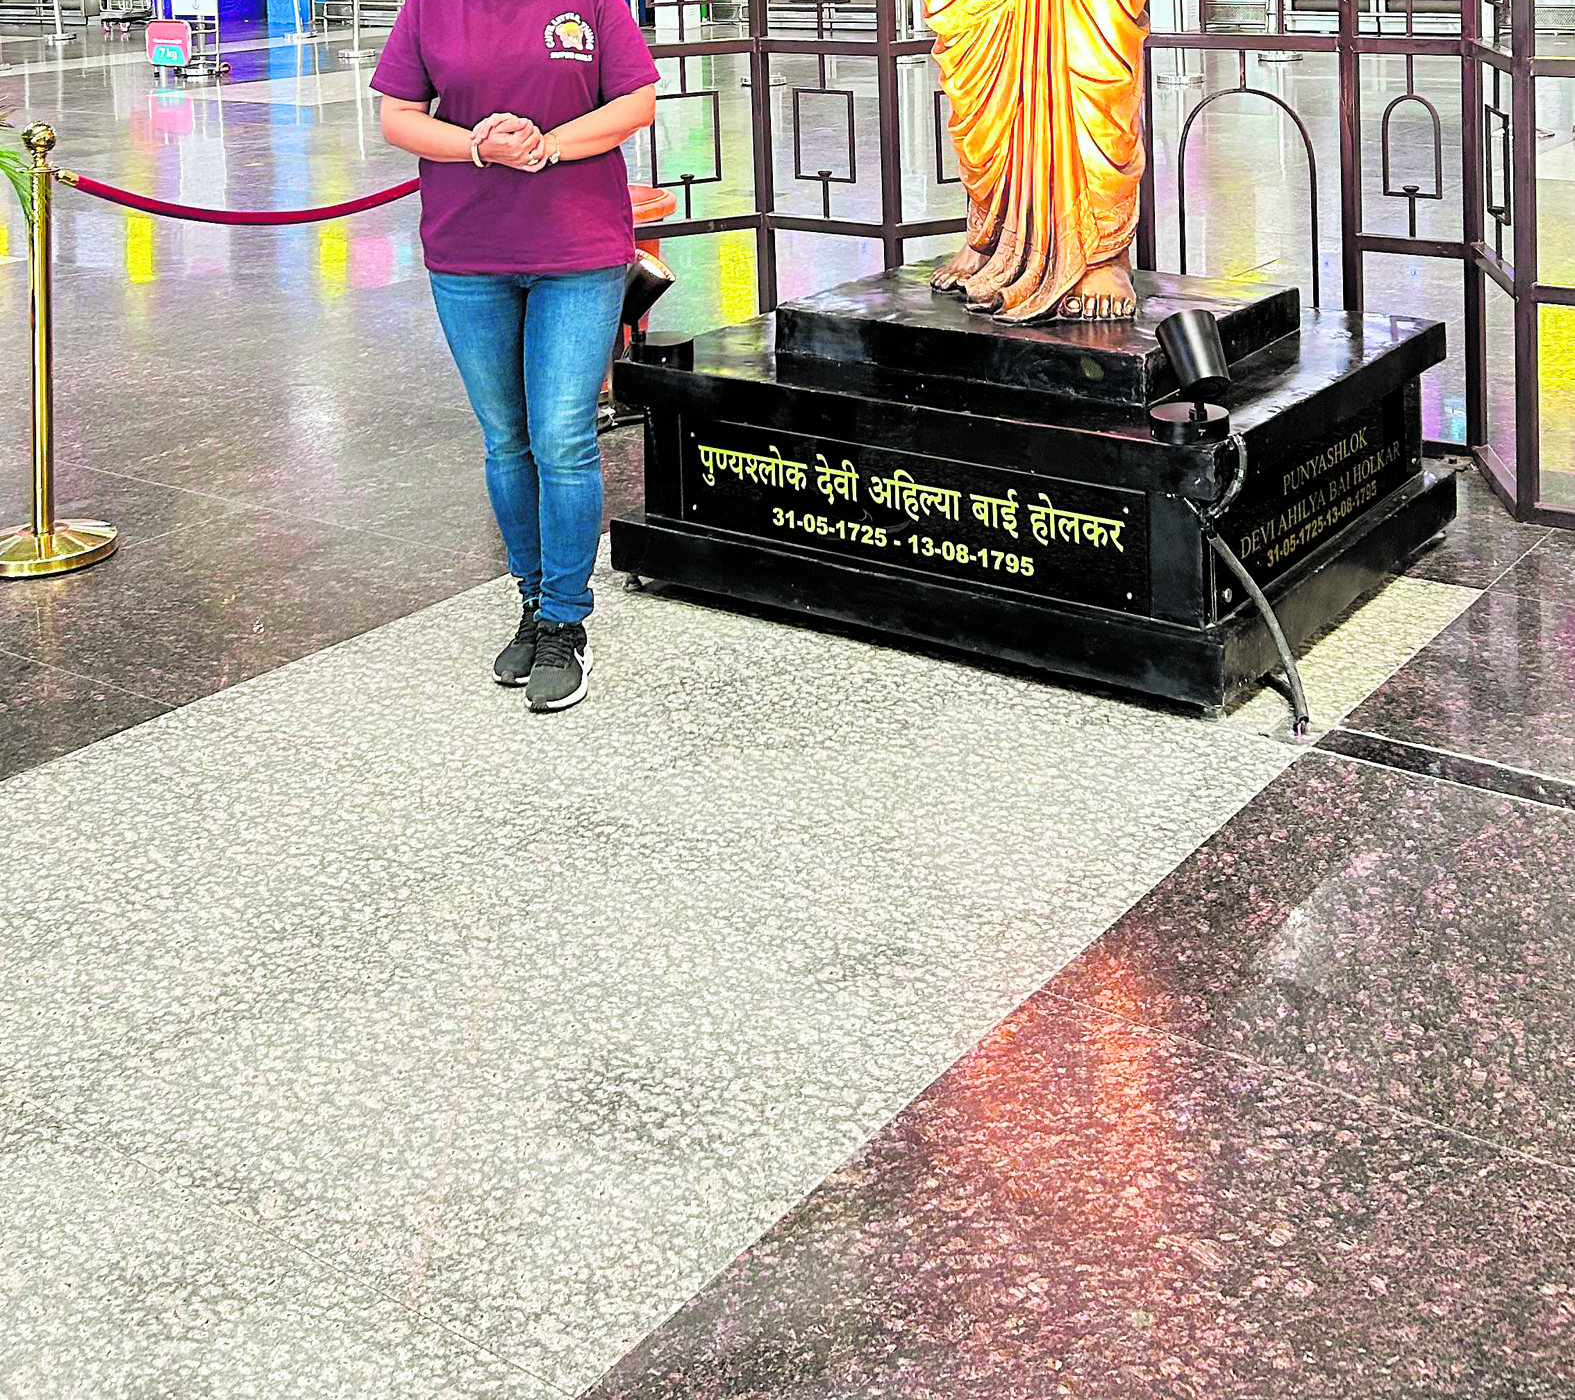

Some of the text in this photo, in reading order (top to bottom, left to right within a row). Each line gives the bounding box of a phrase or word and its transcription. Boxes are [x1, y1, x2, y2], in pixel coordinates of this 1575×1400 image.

[158, 47, 178, 62] 7 kg
[1283, 427, 1368, 496] PUNYASHLOK
[698, 445, 1126, 553] पुण्यश्लोक देवी अहिल्या बाई होलकर
[1240, 441, 1401, 560] DEVI AHILYA BAI HOLKAR
[772, 507, 888, 548] 31-05-1725
[907, 534, 1035, 577] 13-08-1795
